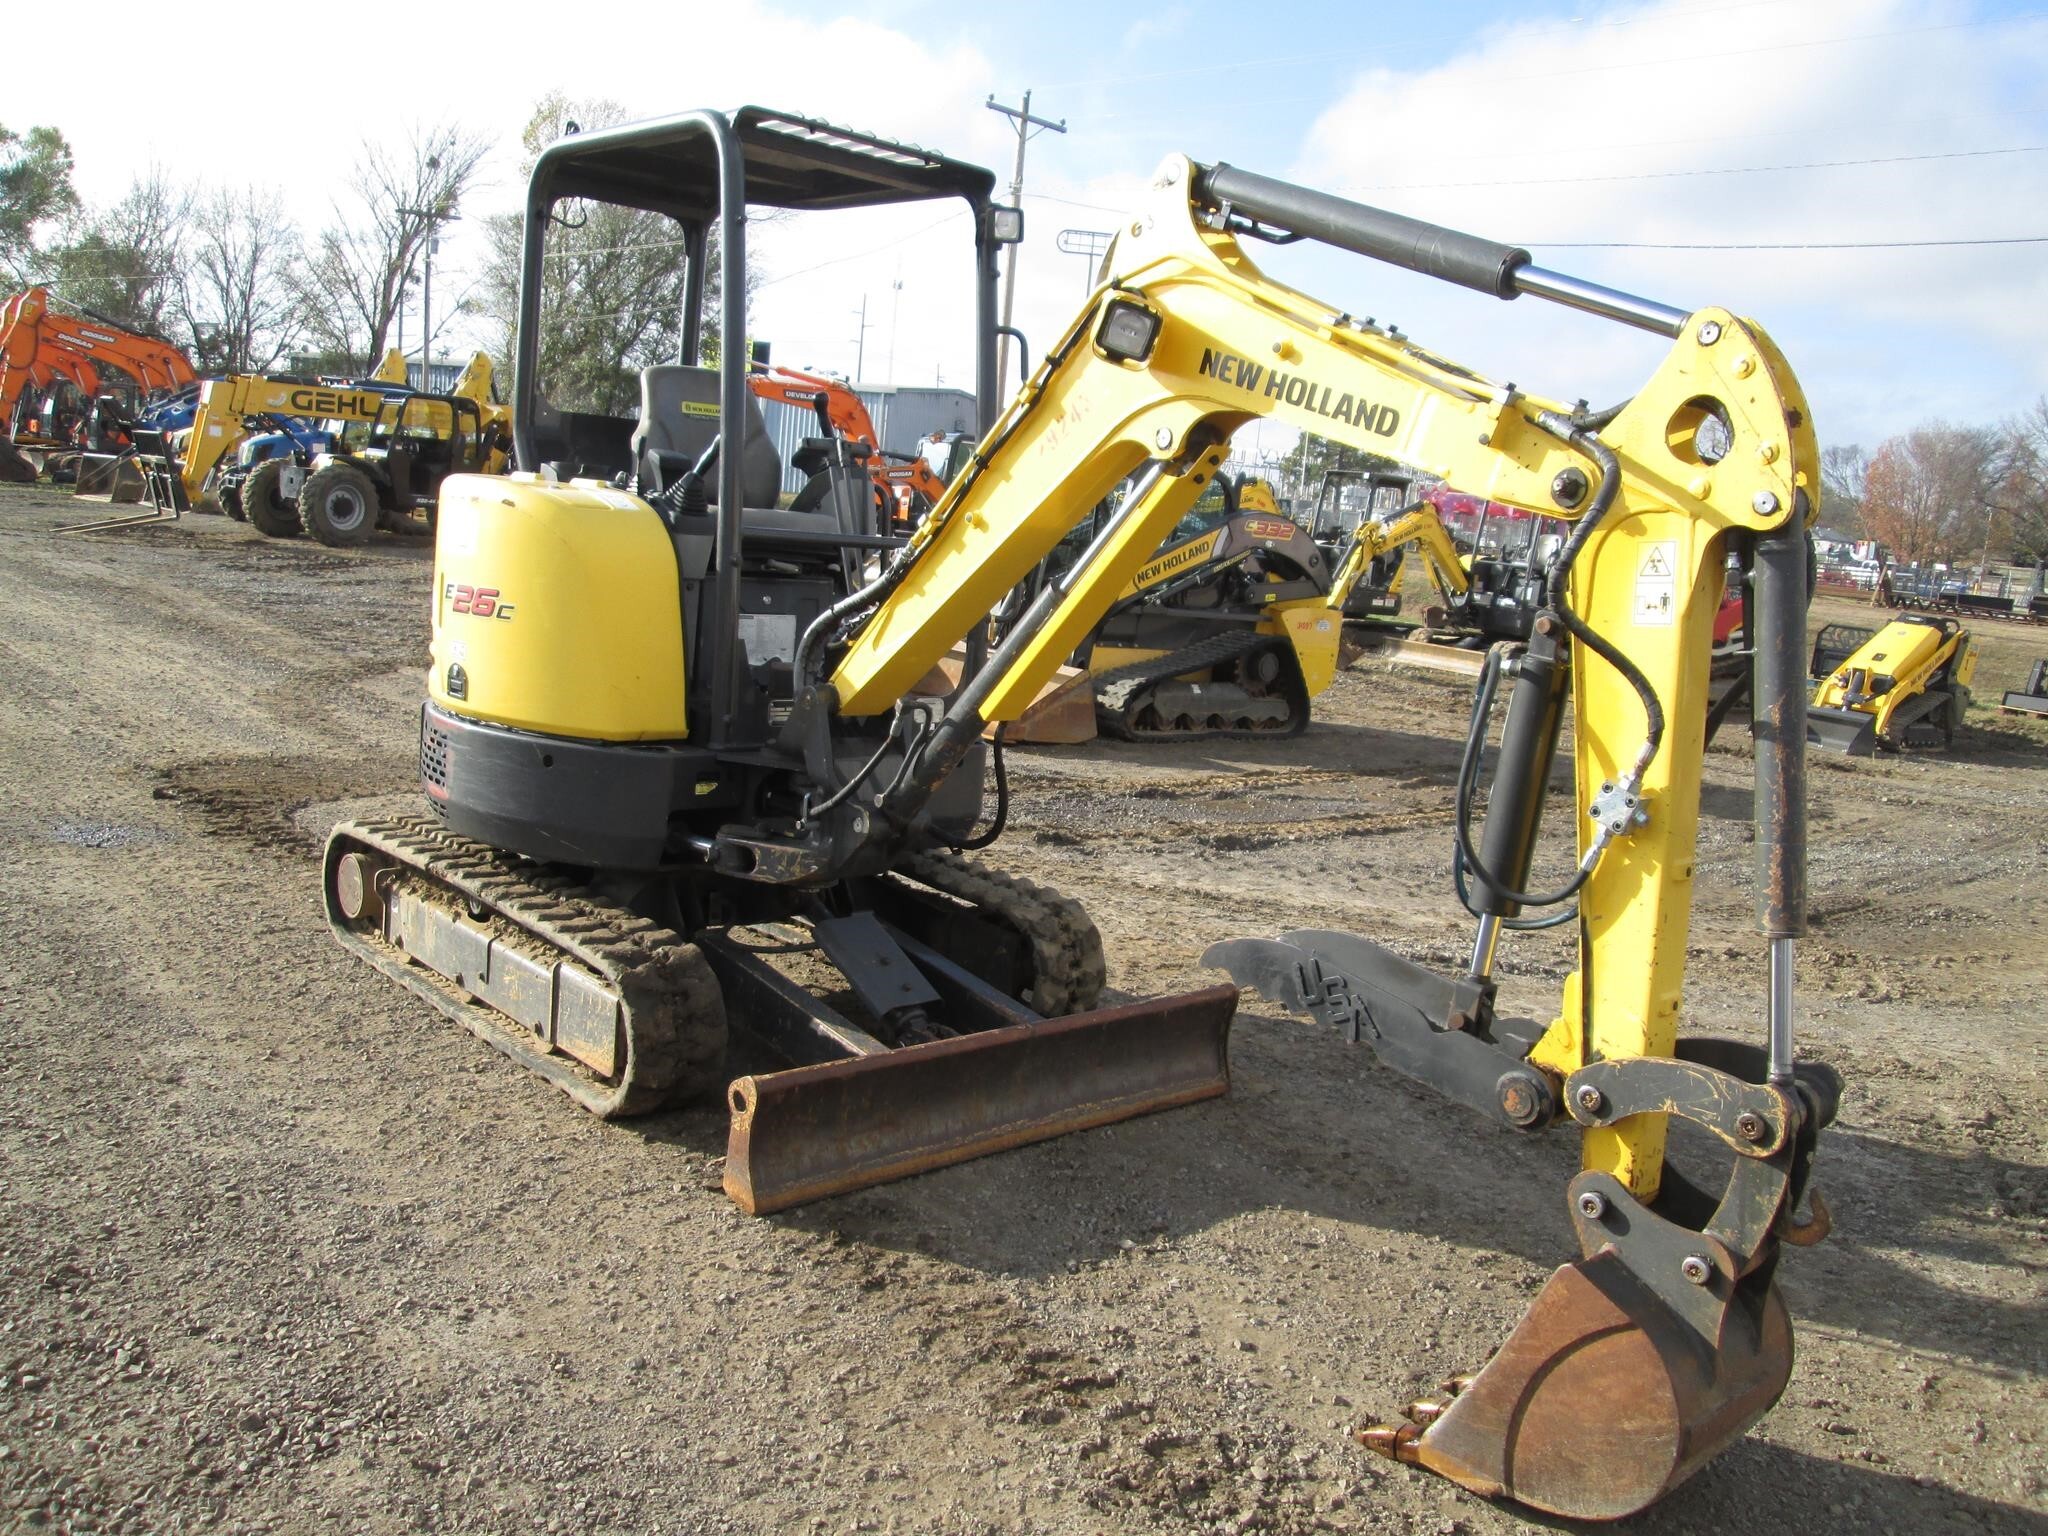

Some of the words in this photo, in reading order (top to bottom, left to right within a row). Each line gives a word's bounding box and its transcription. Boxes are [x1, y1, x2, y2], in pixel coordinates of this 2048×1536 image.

[57, 333, 95, 349] DOOSAN
[80, 329, 116, 343] DOOSAN
[291, 389, 378, 417] GEHL
[785, 391, 815, 399] DEVELO
[1199, 347, 1264, 391] NEW
[1264, 369, 1400, 437] HOLLAND
[1137, 564, 1161, 583] NEW
[1163, 541, 1210, 571] HOLLAND
[1294, 958, 1381, 1042] USA
